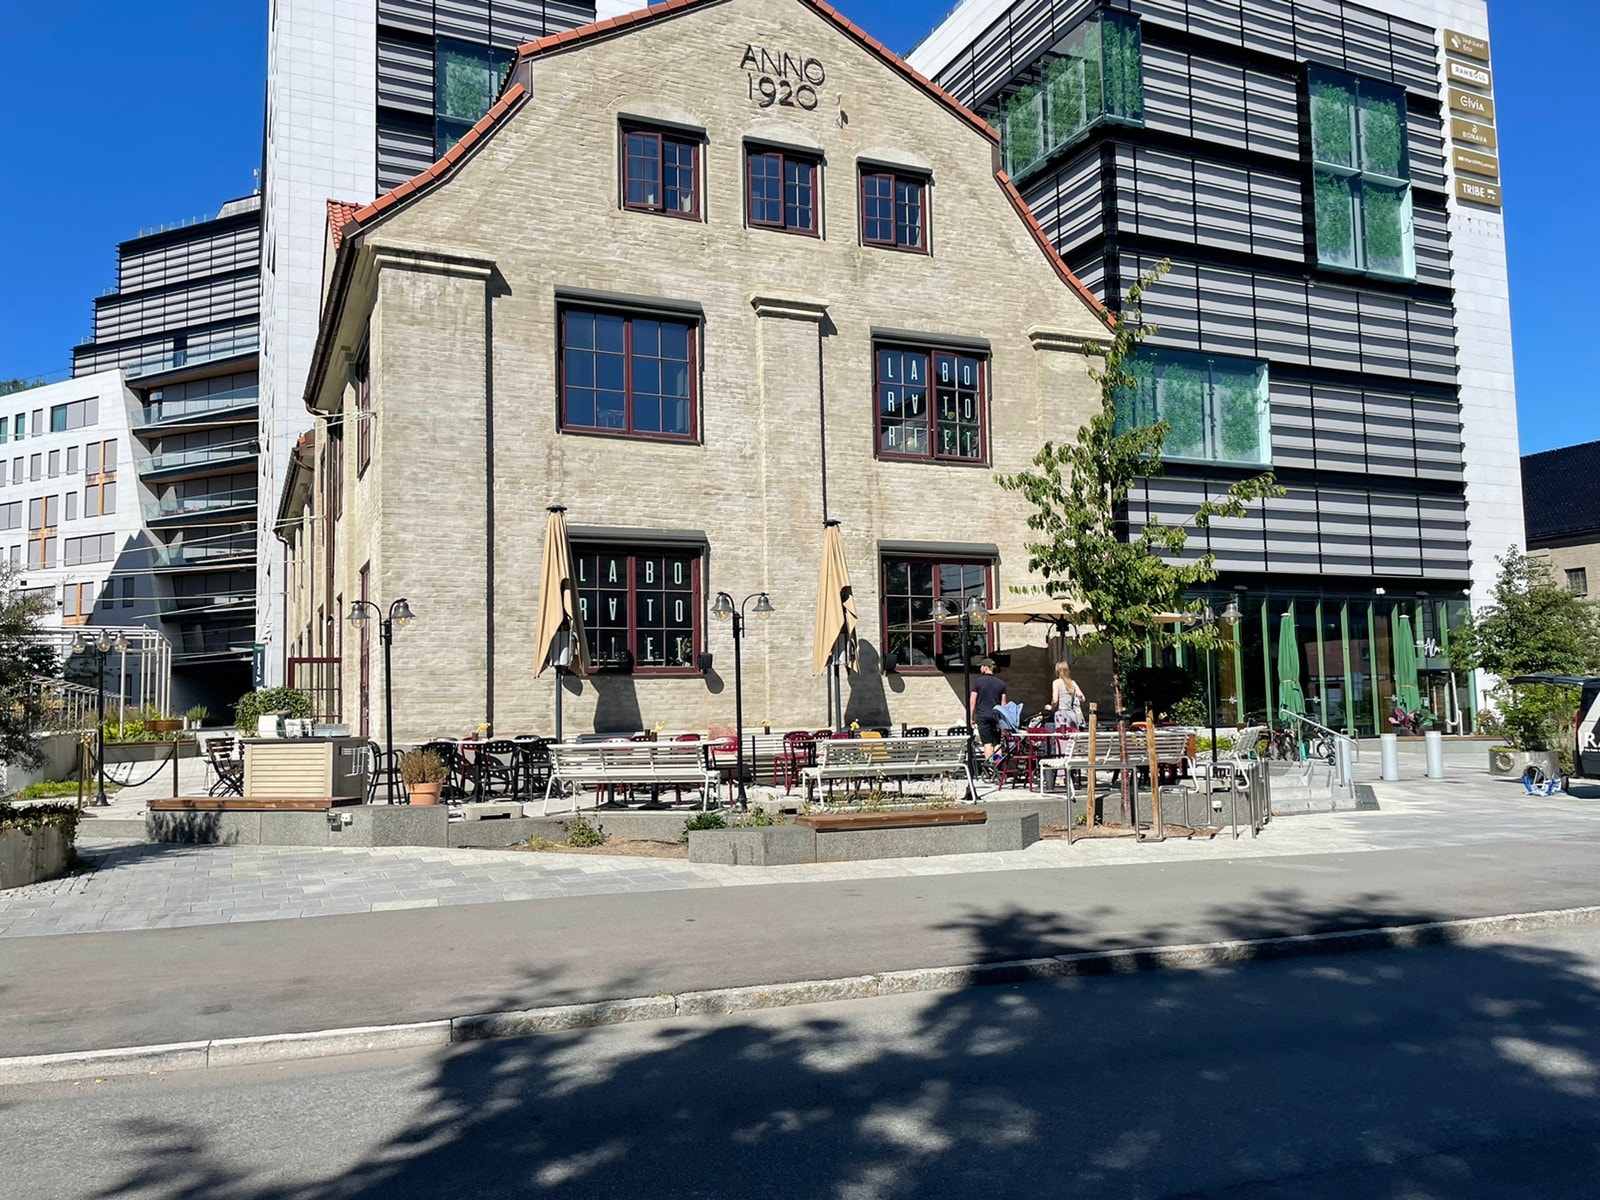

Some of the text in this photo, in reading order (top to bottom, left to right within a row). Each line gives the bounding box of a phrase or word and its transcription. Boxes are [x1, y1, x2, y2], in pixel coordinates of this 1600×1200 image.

[740, 44, 825, 86] ANNO
[748, 72, 818, 111] 1920
[1462, 130, 1487, 143] BONAVA
[1462, 183, 1485, 197] TRIBE
